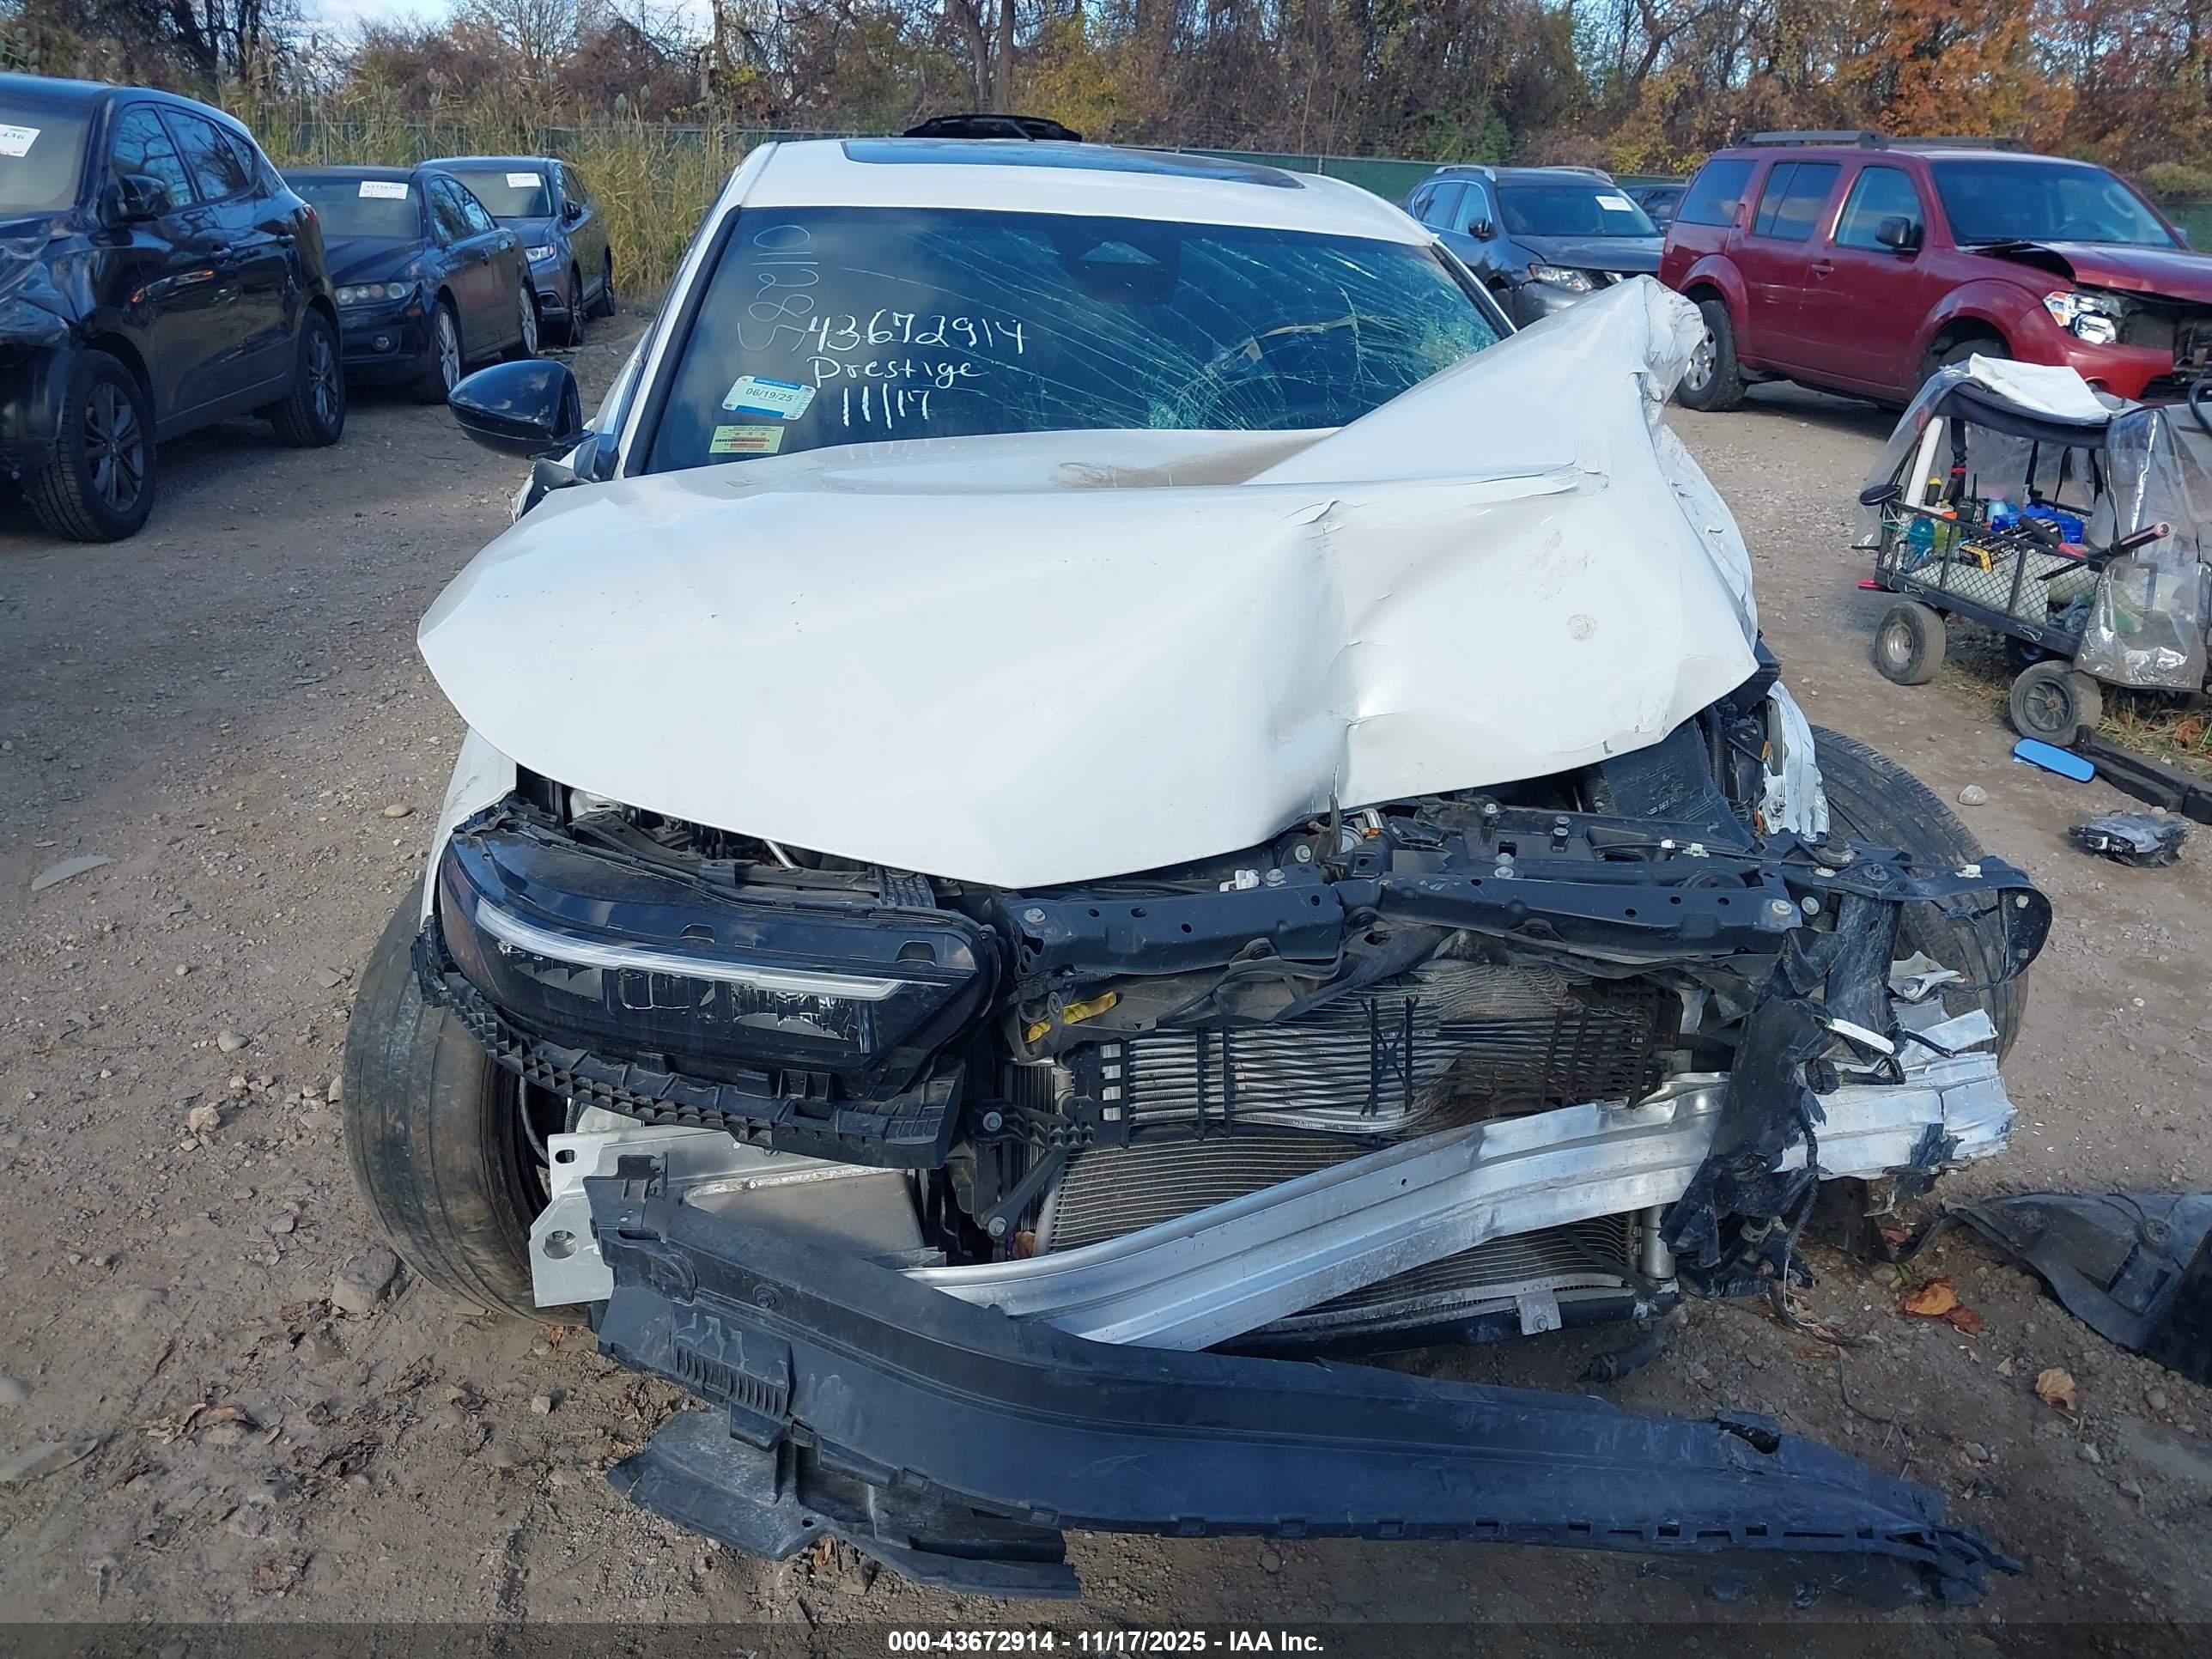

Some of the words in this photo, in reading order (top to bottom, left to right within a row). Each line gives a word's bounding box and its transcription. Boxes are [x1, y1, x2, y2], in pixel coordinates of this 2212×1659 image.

[807, 309, 1025, 355] 43672914
[806, 356, 989, 389] Prestige
[745, 387, 794, 402] 06/19/25
[842, 383, 930, 429] 11/17
